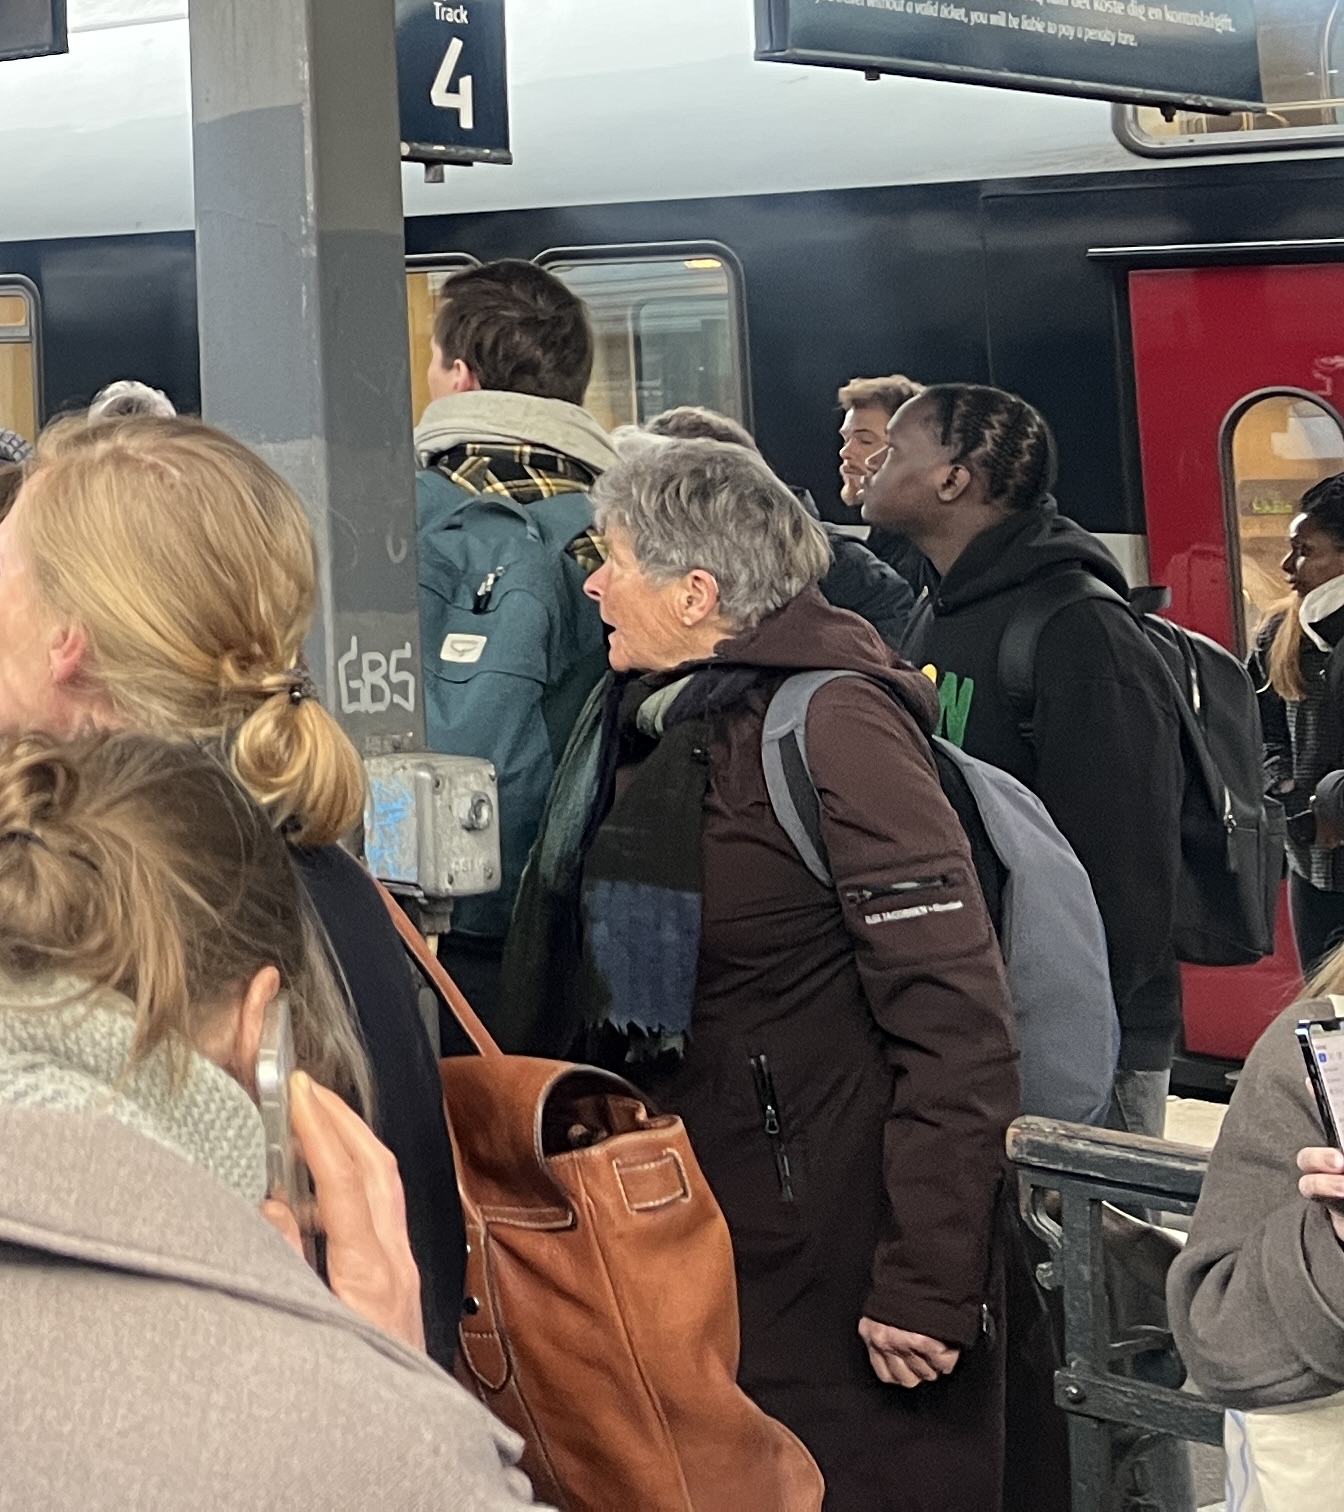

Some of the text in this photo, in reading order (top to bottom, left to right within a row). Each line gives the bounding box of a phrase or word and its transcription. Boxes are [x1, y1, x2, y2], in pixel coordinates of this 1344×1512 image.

[433, 1, 469, 24] Track
[906, 1, 914, 14] a
[914, 0, 939, 18] valid
[939, 4, 969, 24] ticket,
[969, 11, 988, 26] you
[989, 10, 1007, 28] will
[1008, 12, 1020, 29] be
[1020, 14, 1047, 34] liable
[1047, 21, 1058, 35] to
[1058, 23, 1075, 40] pay
[1148, 6, 1163, 22] en
[1164, 4, 1236, 34] kontrolafgift.
[430, 36, 474, 130] 4
[338, 635, 415, 714] GBS
